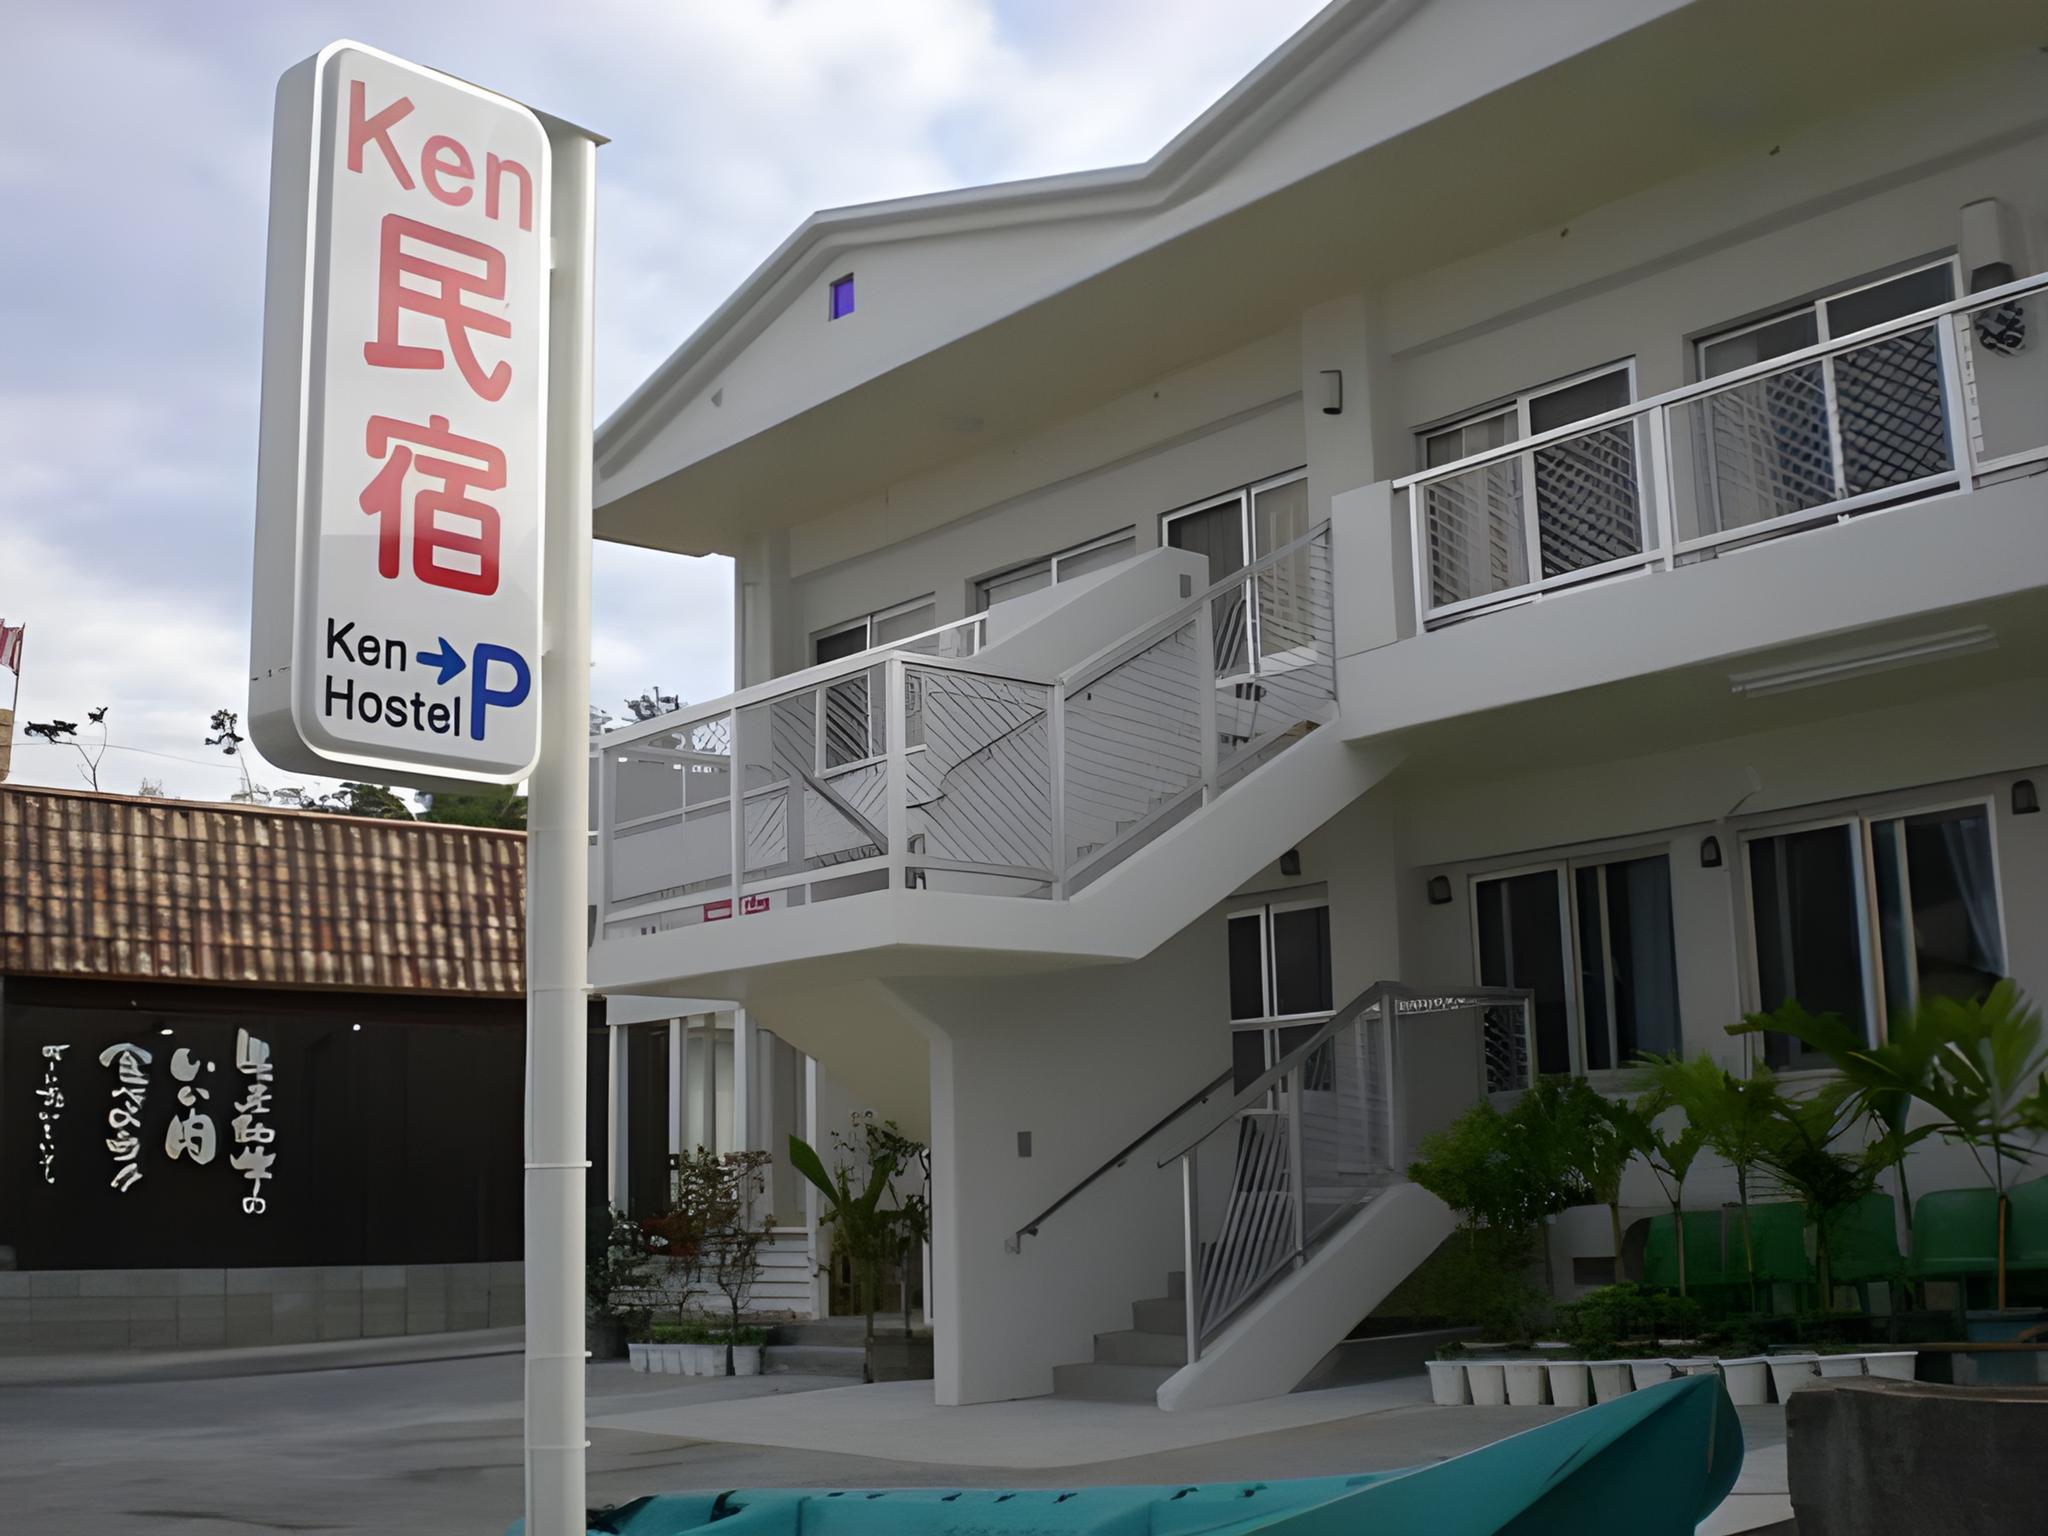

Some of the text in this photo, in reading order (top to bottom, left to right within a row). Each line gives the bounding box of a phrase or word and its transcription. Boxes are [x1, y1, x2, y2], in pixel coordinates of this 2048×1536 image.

[347, 80, 533, 232] Ken
[359, 213, 513, 597] 民宿
[326, 617, 407, 672] Ken
[470, 642, 531, 741] P
[325, 675, 461, 737] Hostel
